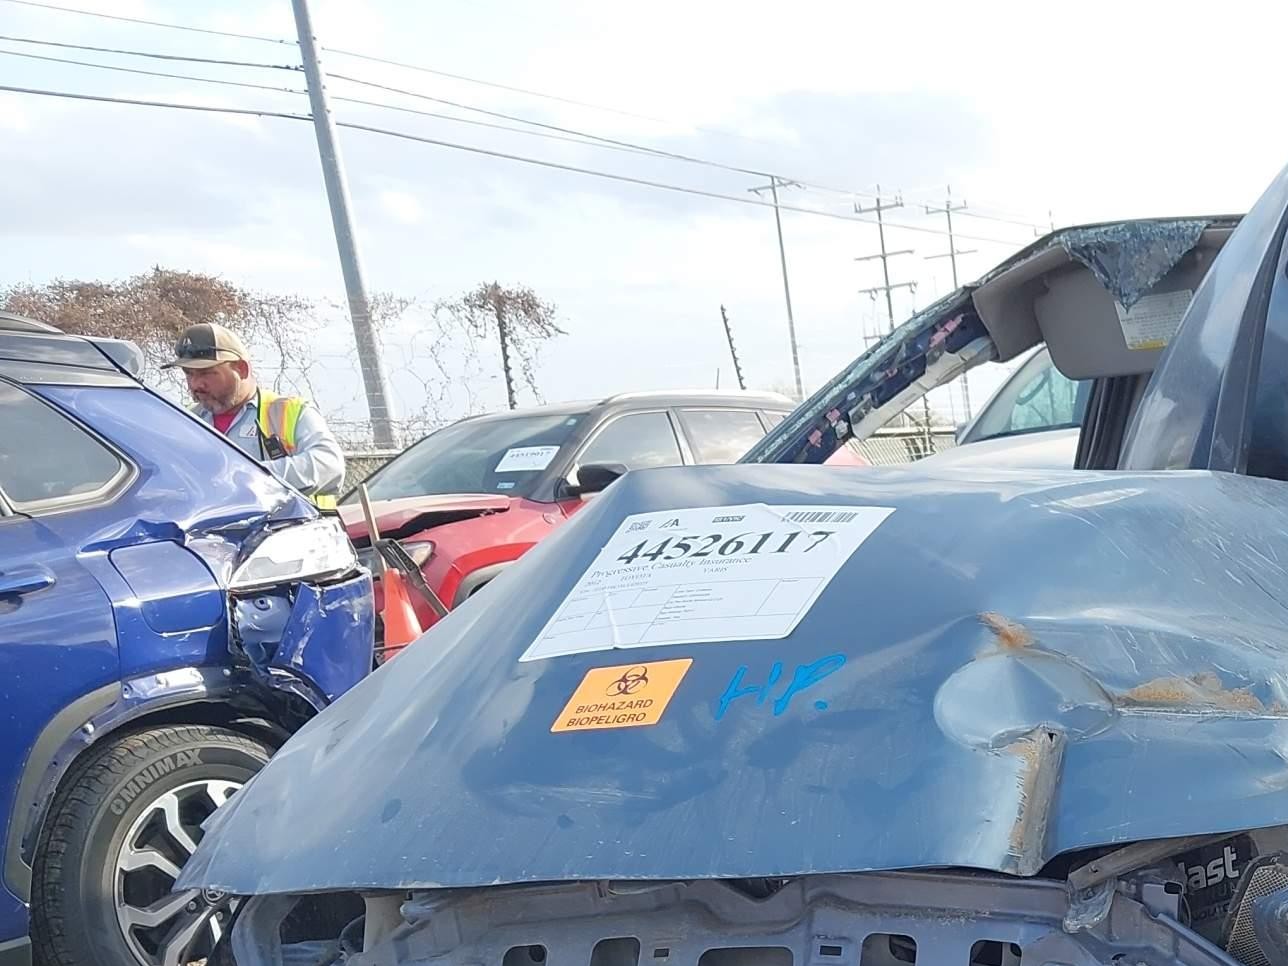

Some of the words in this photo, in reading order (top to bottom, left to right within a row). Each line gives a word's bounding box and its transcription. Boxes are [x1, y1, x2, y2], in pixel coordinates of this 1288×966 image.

[617, 531, 835, 564] 44526117
[591, 565, 648, 578] Progressive
[651, 560, 695, 570] Casualty
[699, 558, 752, 566] Insurance
[575, 699, 653, 713] BIOHAZARD
[567, 713, 646, 726] BIOPELIGRO
[111, 748, 205, 816] OMNIMAX
